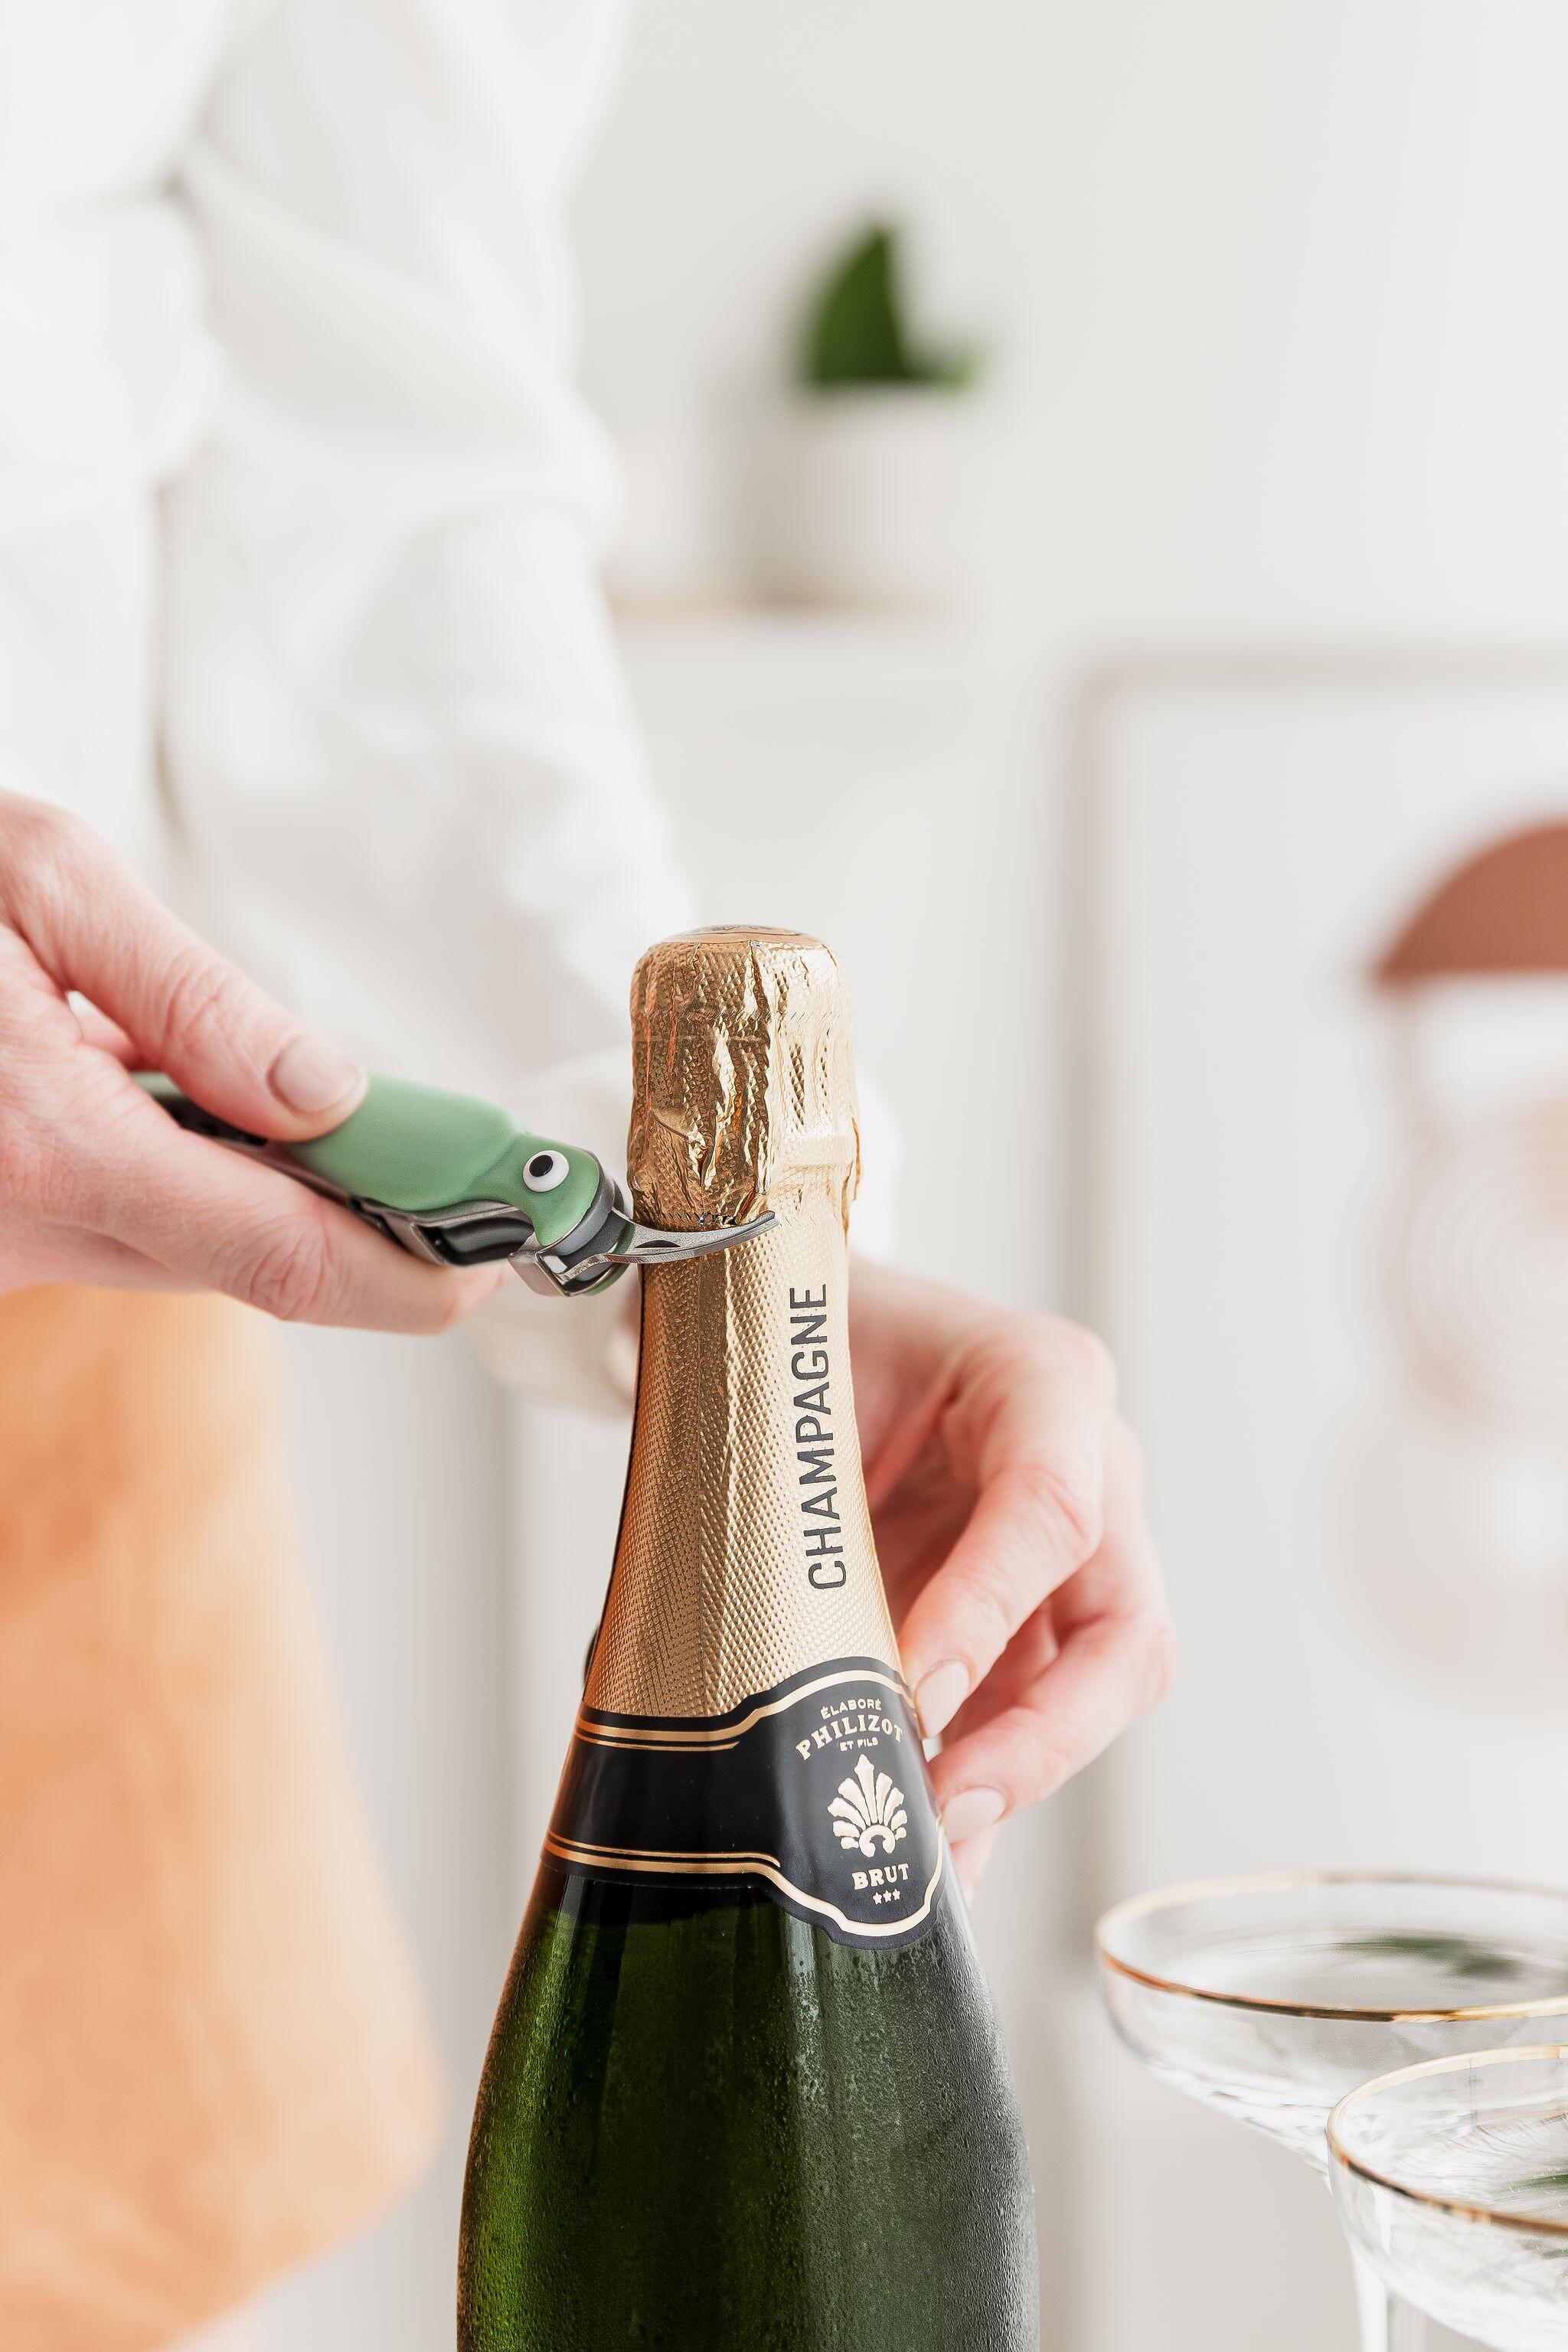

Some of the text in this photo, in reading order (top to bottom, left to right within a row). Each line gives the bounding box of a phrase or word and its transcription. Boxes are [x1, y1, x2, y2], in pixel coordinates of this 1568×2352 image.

[789, 1283, 847, 1590] CHAMPAGNE
[820, 1698, 882, 1720] ÉLABORÉ
[795, 1714, 903, 1761] PHILIZOT
[839, 1736, 878, 1751] ET FILS
[851, 1863, 910, 1890] BRUT
